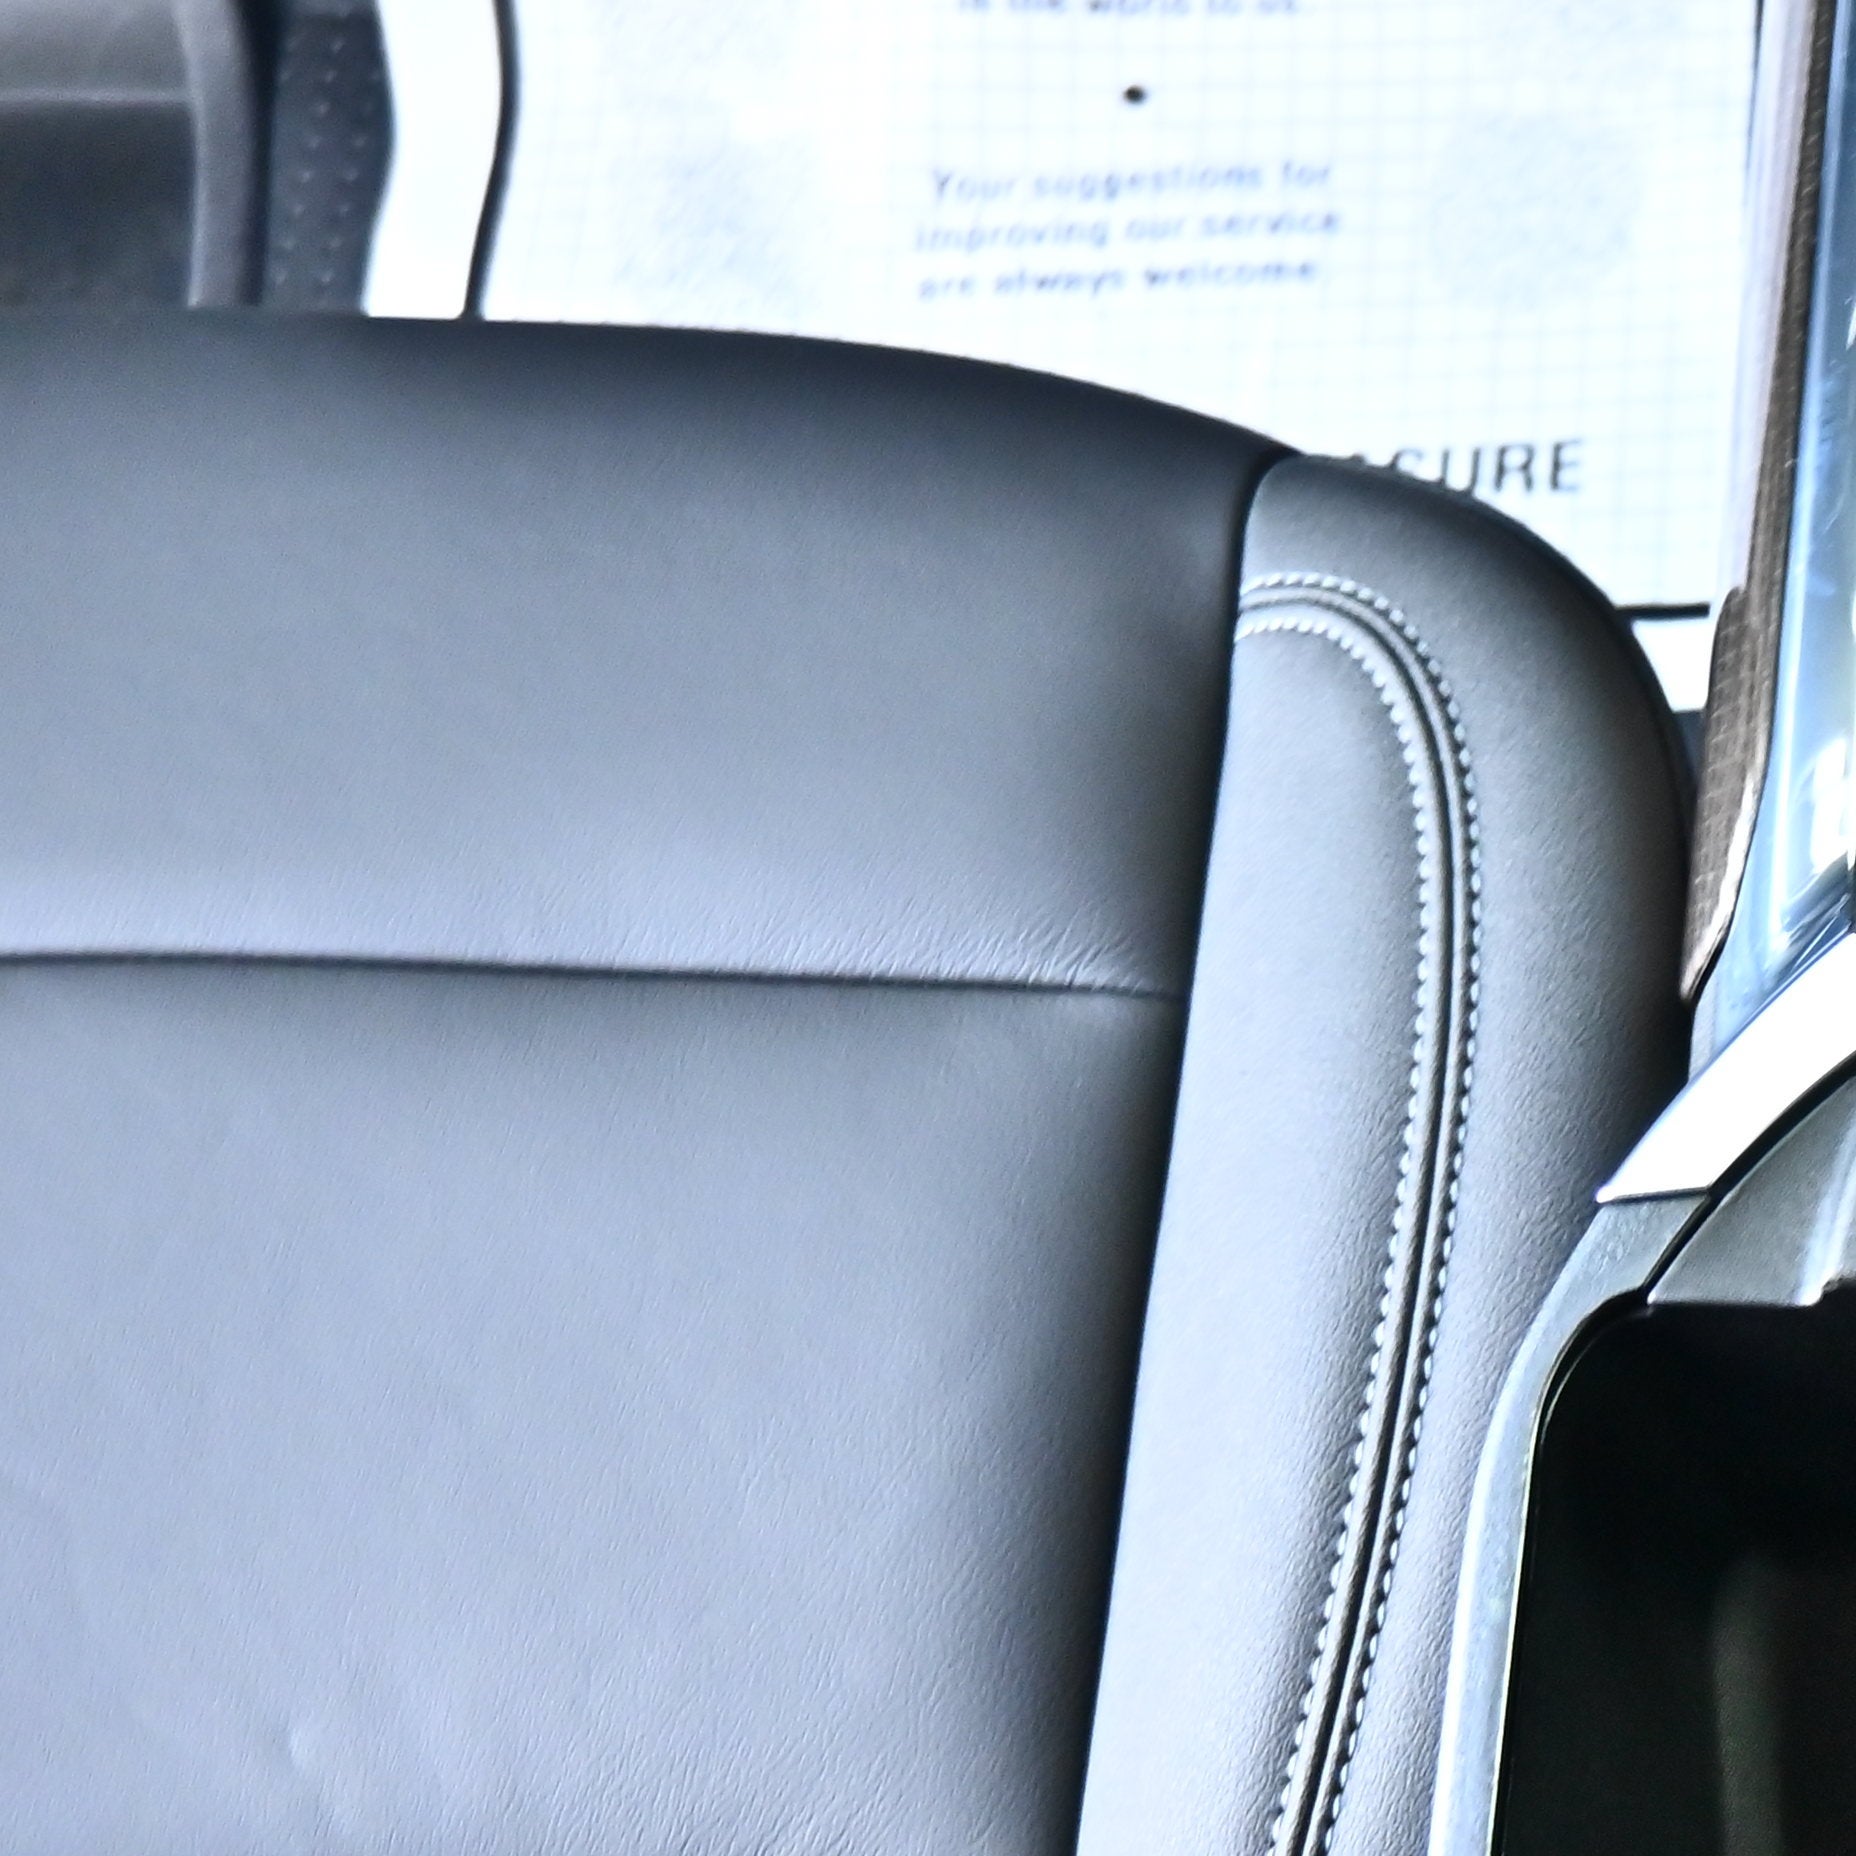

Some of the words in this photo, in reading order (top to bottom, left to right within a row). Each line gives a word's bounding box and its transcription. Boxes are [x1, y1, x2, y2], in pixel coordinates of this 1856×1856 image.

[932, 164, 1016, 202] Your
[1033, 164, 1262, 203] suggestions
[1281, 158, 1331, 188] for
[914, 220, 1109, 254] improving
[1125, 217, 1184, 240] our
[1201, 210, 1340, 238] service
[918, 277, 976, 300] are
[994, 268, 1125, 299] always
